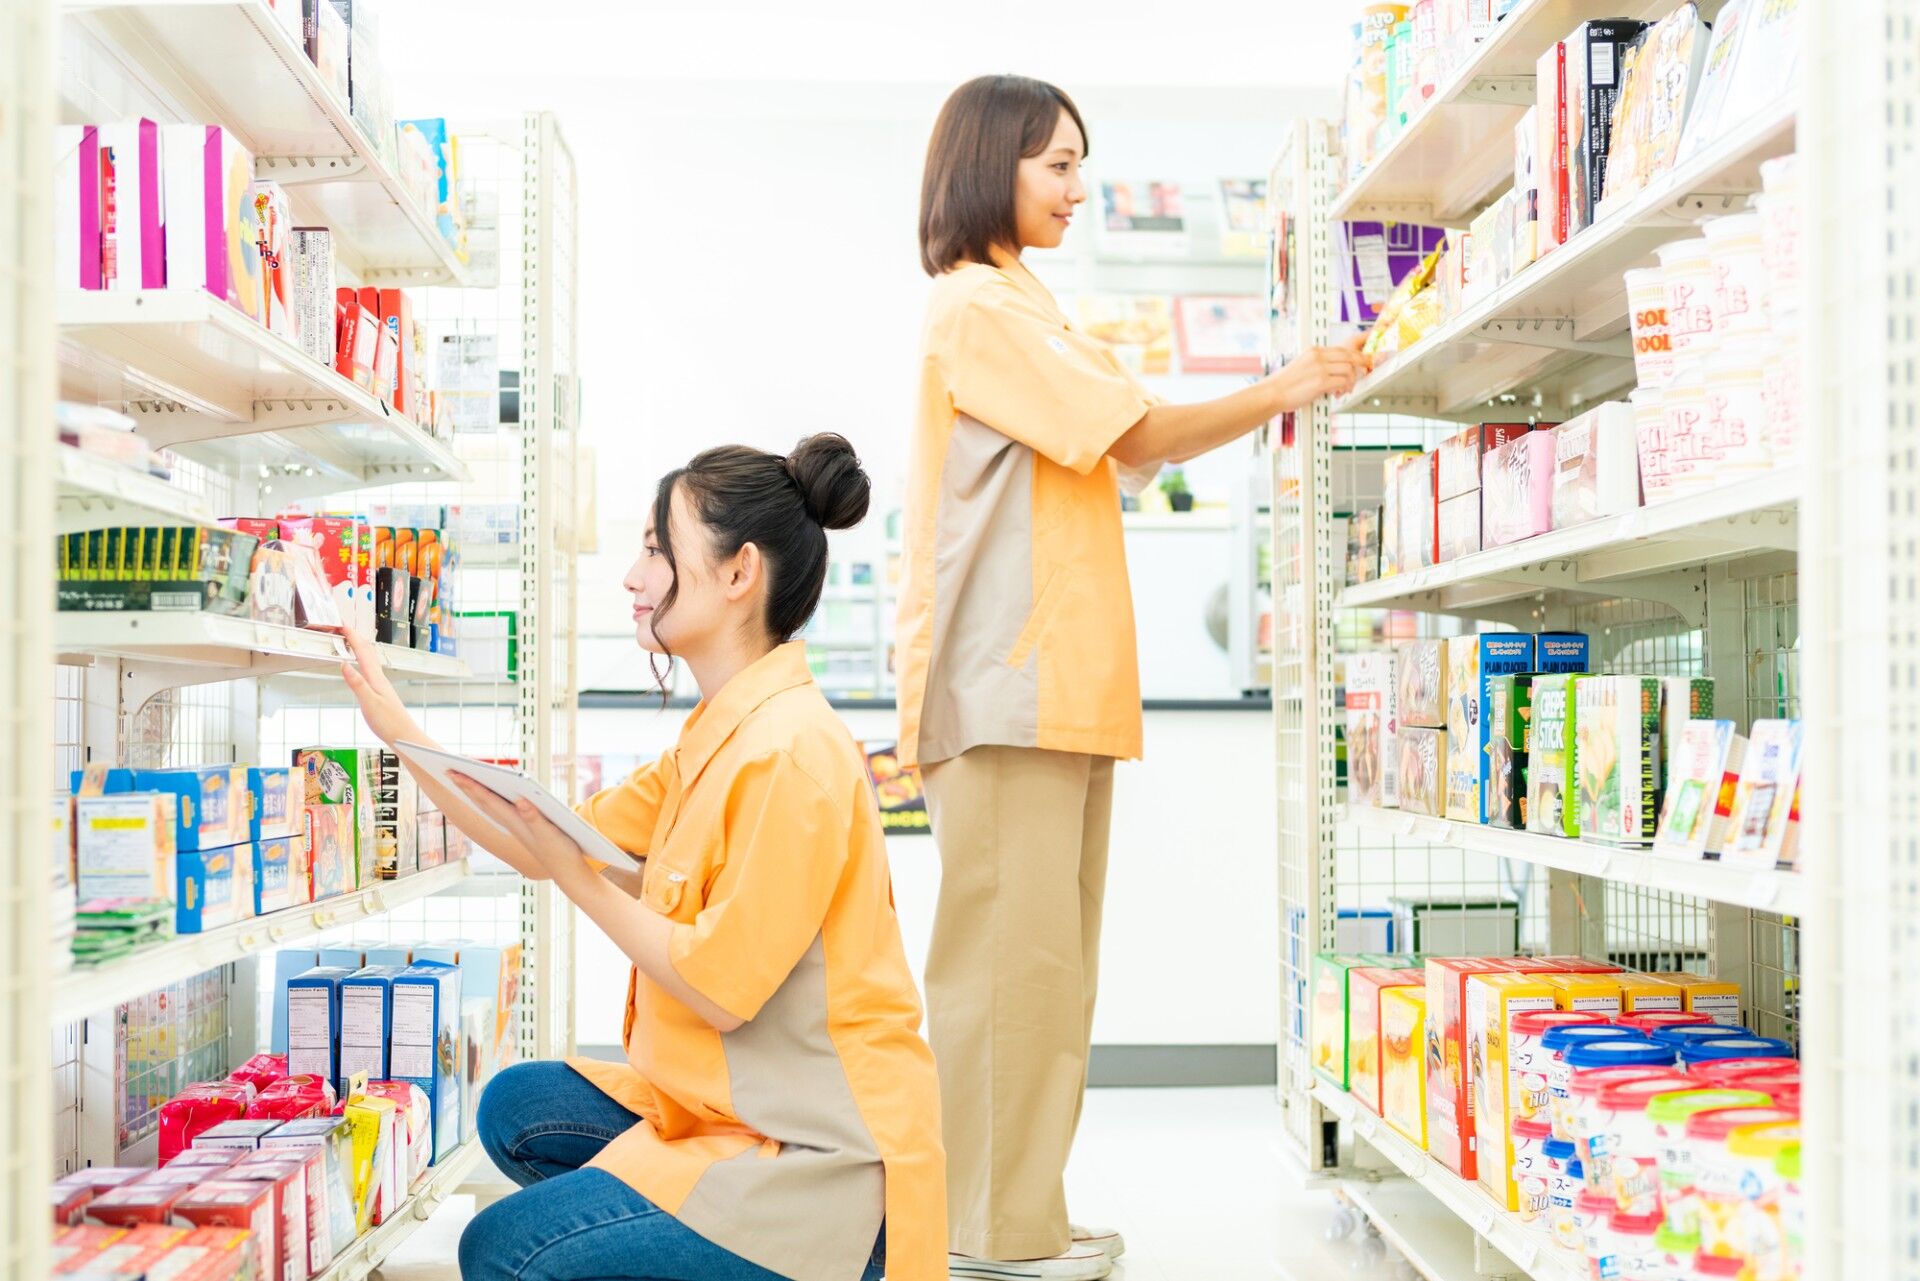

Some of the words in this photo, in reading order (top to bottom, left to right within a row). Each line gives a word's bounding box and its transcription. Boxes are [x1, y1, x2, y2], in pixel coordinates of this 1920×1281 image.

[1485, 661, 1502, 673] PLAIN
[1503, 661, 1528, 673] CRACKER
[1542, 661, 1559, 673] PLAIN
[1560, 661, 1585, 673] CRACKER
[1540, 690, 1566, 718] CREPE
[1539, 720, 1564, 750] STICK
